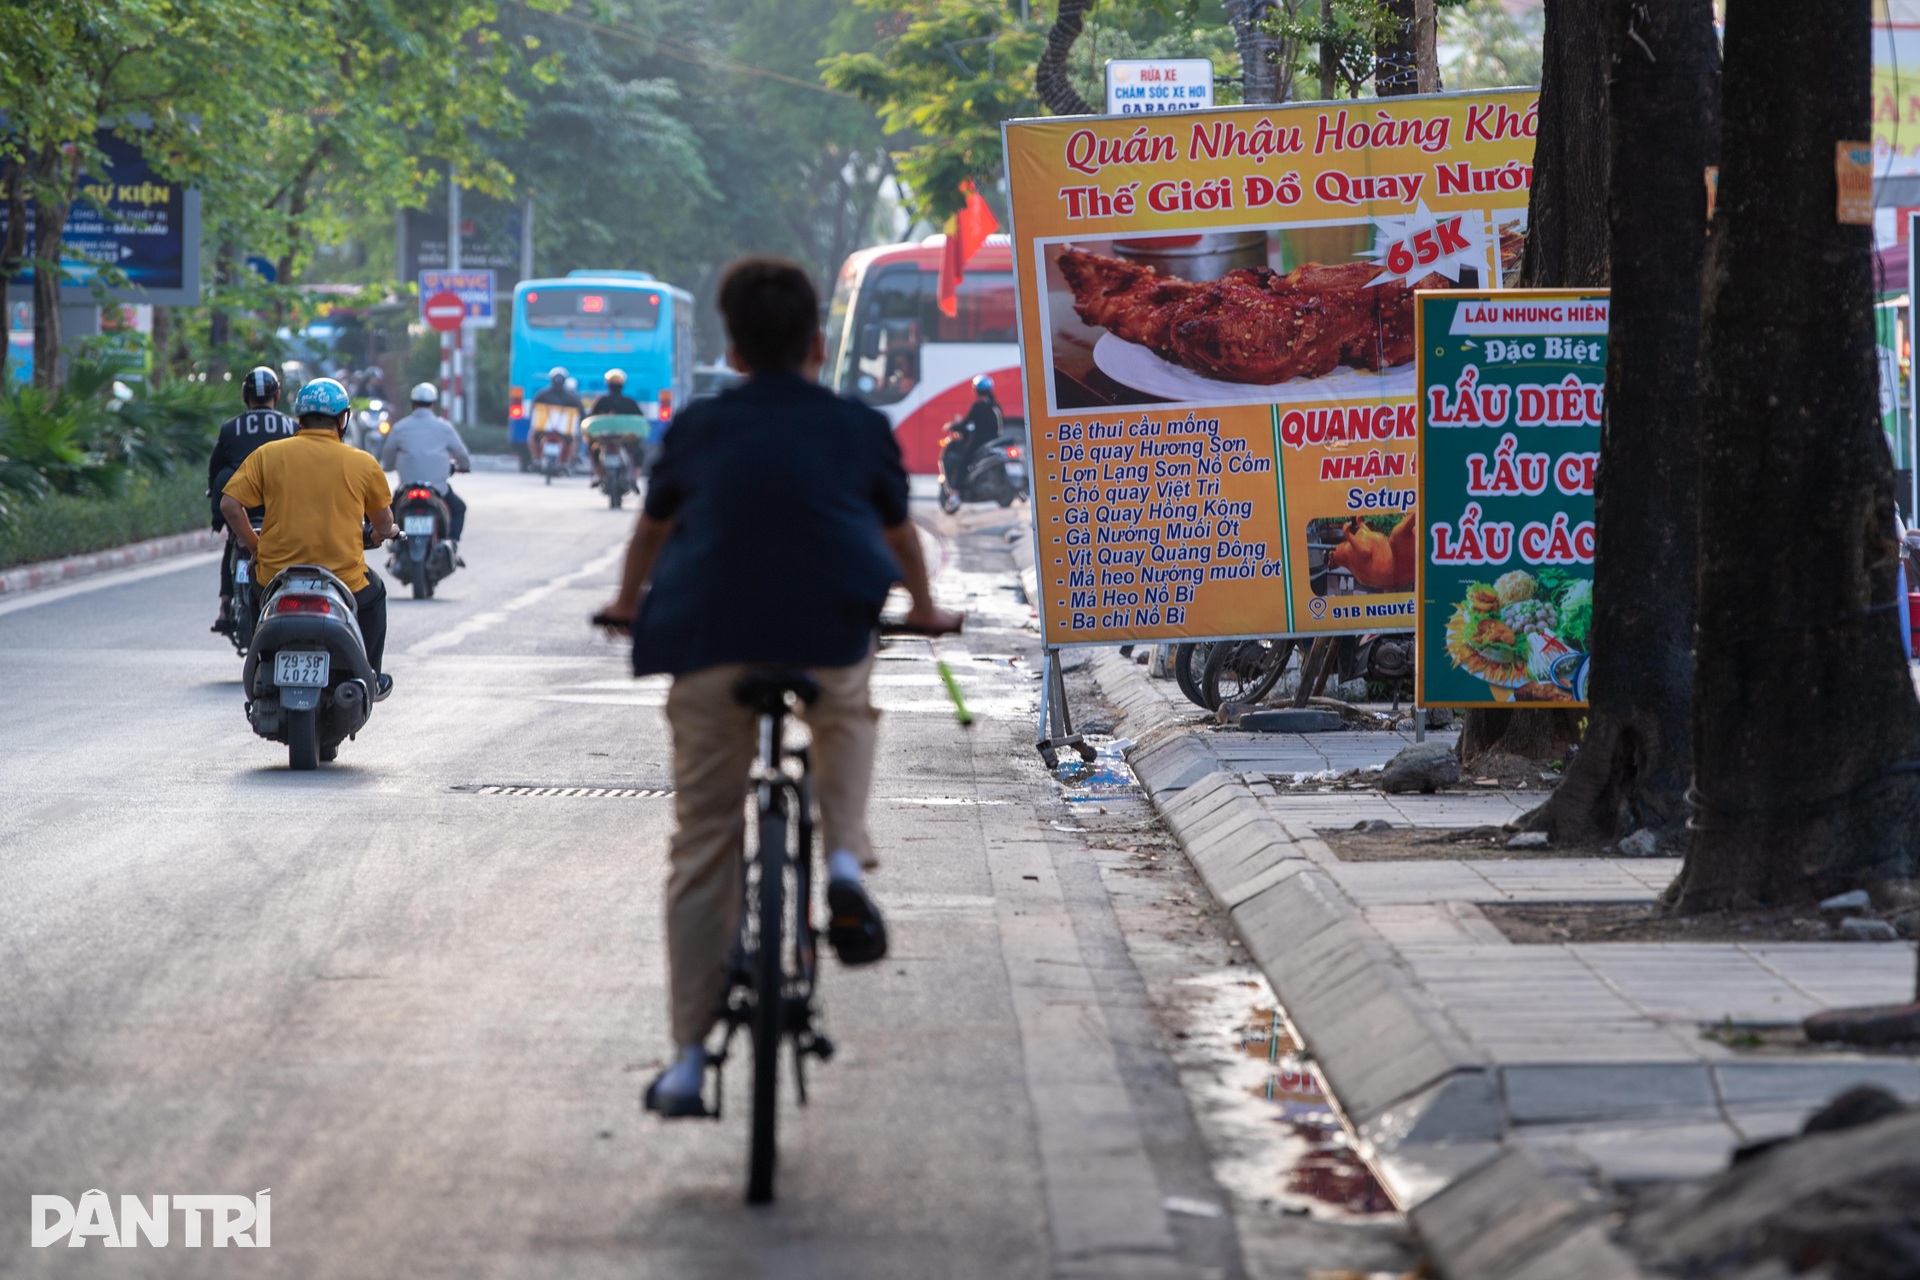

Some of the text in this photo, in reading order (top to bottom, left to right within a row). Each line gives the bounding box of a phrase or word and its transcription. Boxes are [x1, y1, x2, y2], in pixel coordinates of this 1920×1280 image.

[1140, 65, 1177, 80] RỬA XE
[1115, 85, 1145, 98] CHĂM
[1149, 84, 1169, 98] SÓC
[1173, 86, 1185, 97] XE
[1066, 127, 1177, 174] Quán
[1189, 118, 1303, 163] Nhậu
[1315, 110, 1451, 153] Hoàng
[1060, 182, 1140, 218] Thế
[1148, 178, 1233, 212] Giới
[1244, 172, 1301, 207] Đồ
[1315, 171, 1424, 204] Quay
[1387, 217, 1471, 274] 65K
[1502, 307, 1563, 322] NHUNG
[1485, 337, 1601, 364] Đặc Biệt
[1432, 370, 1507, 422] LẨU
[236, 414, 293, 436] ICON
[1058, 413, 1218, 441] Bê thui cầu mống
[1060, 437, 1245, 463] Dê quay Hương Sơn
[1062, 451, 1270, 485] Lợn Lạng Sơn Nổ Cốm
[1321, 450, 1405, 483] NHẬN
[1470, 438, 1546, 490] LẨU
[1064, 478, 1219, 504] Chó quay Việt Trì
[1347, 487, 1415, 511] Setup
[1065, 499, 1251, 524] Gà Quay Hồng Kông
[1067, 516, 1239, 545] Gà Nướng Muối Ớt
[1435, 507, 1511, 559] LẨU
[1068, 540, 1265, 569] Vịt Quay Quảng Đông
[1069, 558, 1281, 587] Má heo Nướng muối ớt
[1070, 583, 1194, 608] Má Heo Nổ Bì
[1072, 605, 1184, 629] Ba chỉ Nổ Bì
[1333, 606, 1360, 618] 91B
[284, 655, 320, 668] 29-S8
[282, 669, 319, 682] 4022
